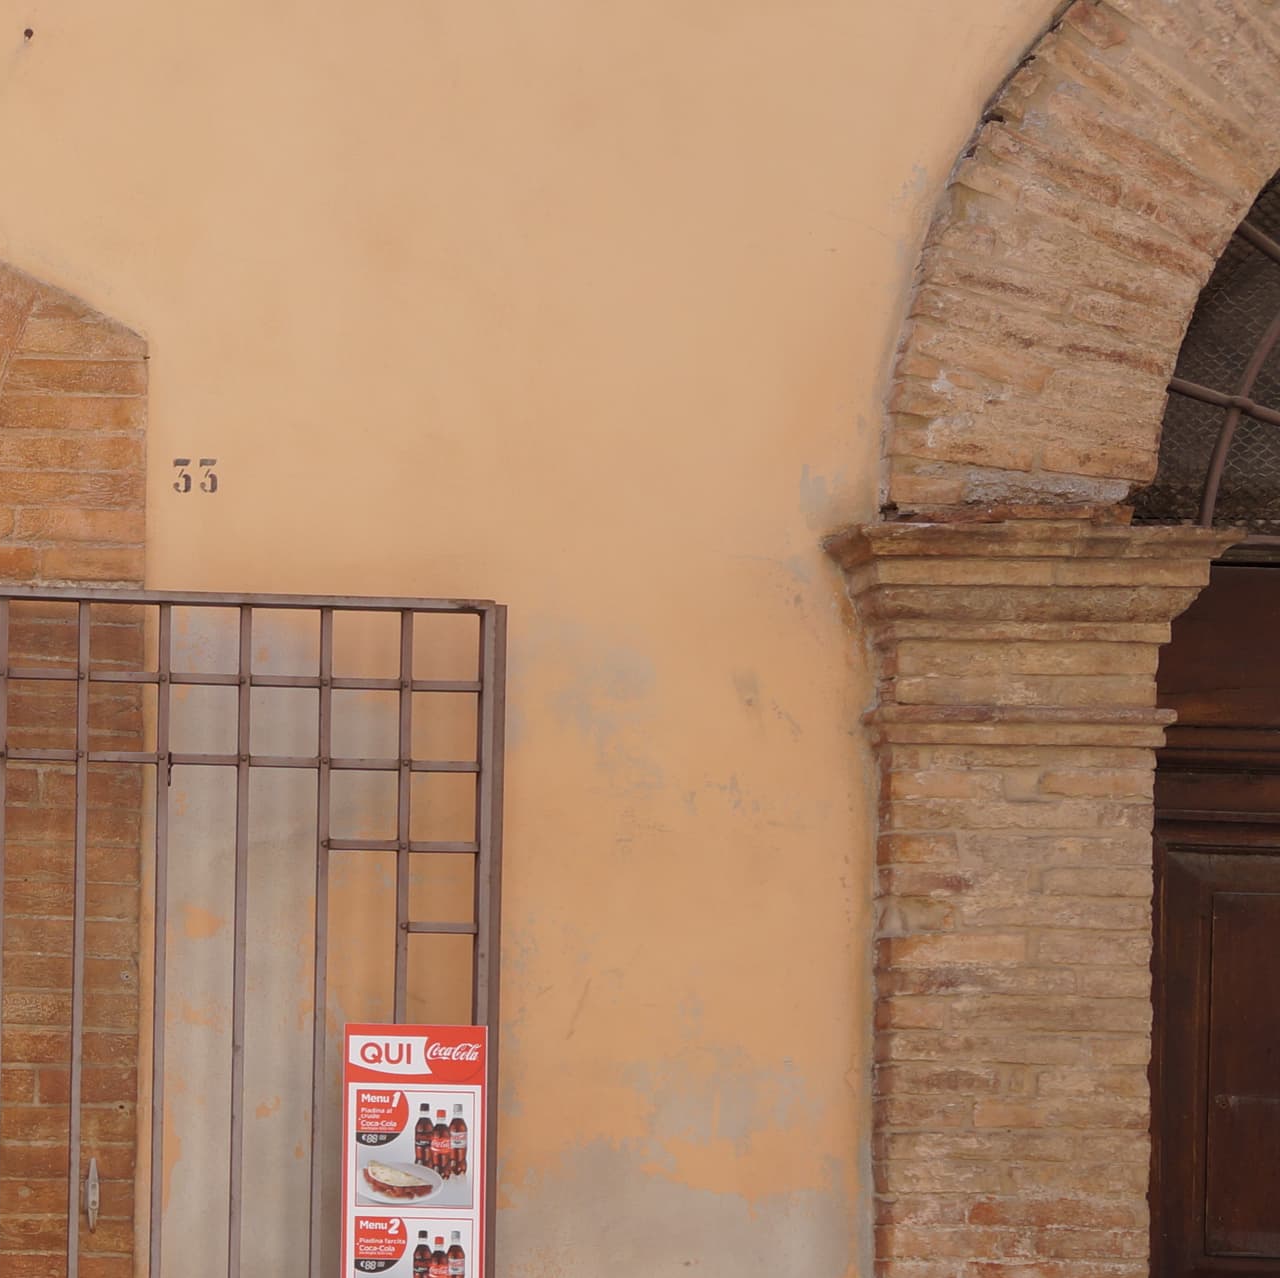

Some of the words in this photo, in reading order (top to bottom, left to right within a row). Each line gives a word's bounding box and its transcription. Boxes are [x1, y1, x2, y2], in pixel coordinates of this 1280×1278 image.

[172, 458, 218, 493] 33
[360, 1042, 412, 1065] QUI
[361, 1093, 390, 1103] Menu
[392, 1092, 401, 1107] 1
[359, 1220, 388, 1230] Menu
[388, 1218, 400, 1234] 2
